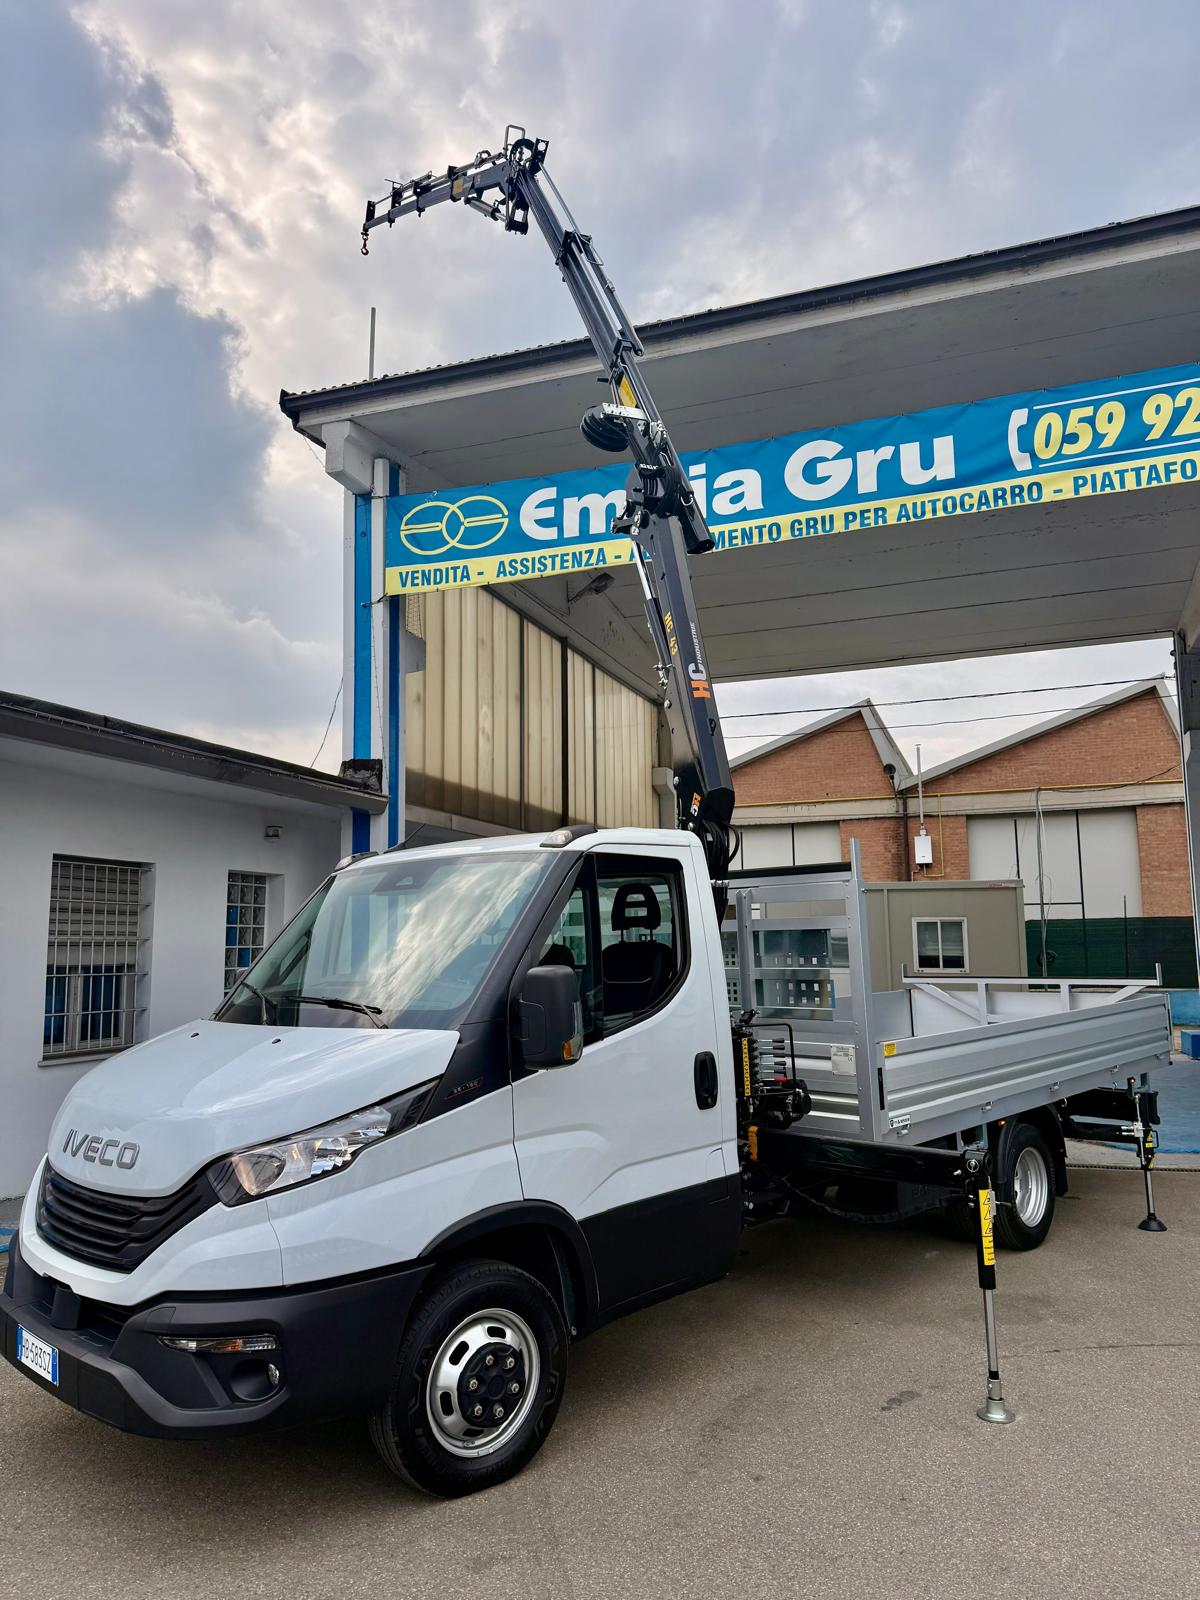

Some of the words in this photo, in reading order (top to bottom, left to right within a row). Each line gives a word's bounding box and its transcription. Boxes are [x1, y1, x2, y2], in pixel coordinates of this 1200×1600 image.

[1033, 400, 1126, 460] 059
[1142, 386, 1200, 442] 92
[399, 564, 471, 588] VENDITA
[496, 547, 607, 578] ASSISTENZA
[790, 514, 834, 538] GRU
[844, 506, 888, 531] PER
[896, 481, 1043, 523] AUTOCARRO
[1072, 458, 1198, 496] PIATTAFO
[519, 462, 764, 541] Emia
[784, 434, 956, 501] Gru
[688, 662, 711, 699] HC
[63, 1128, 140, 1170] IVECO
